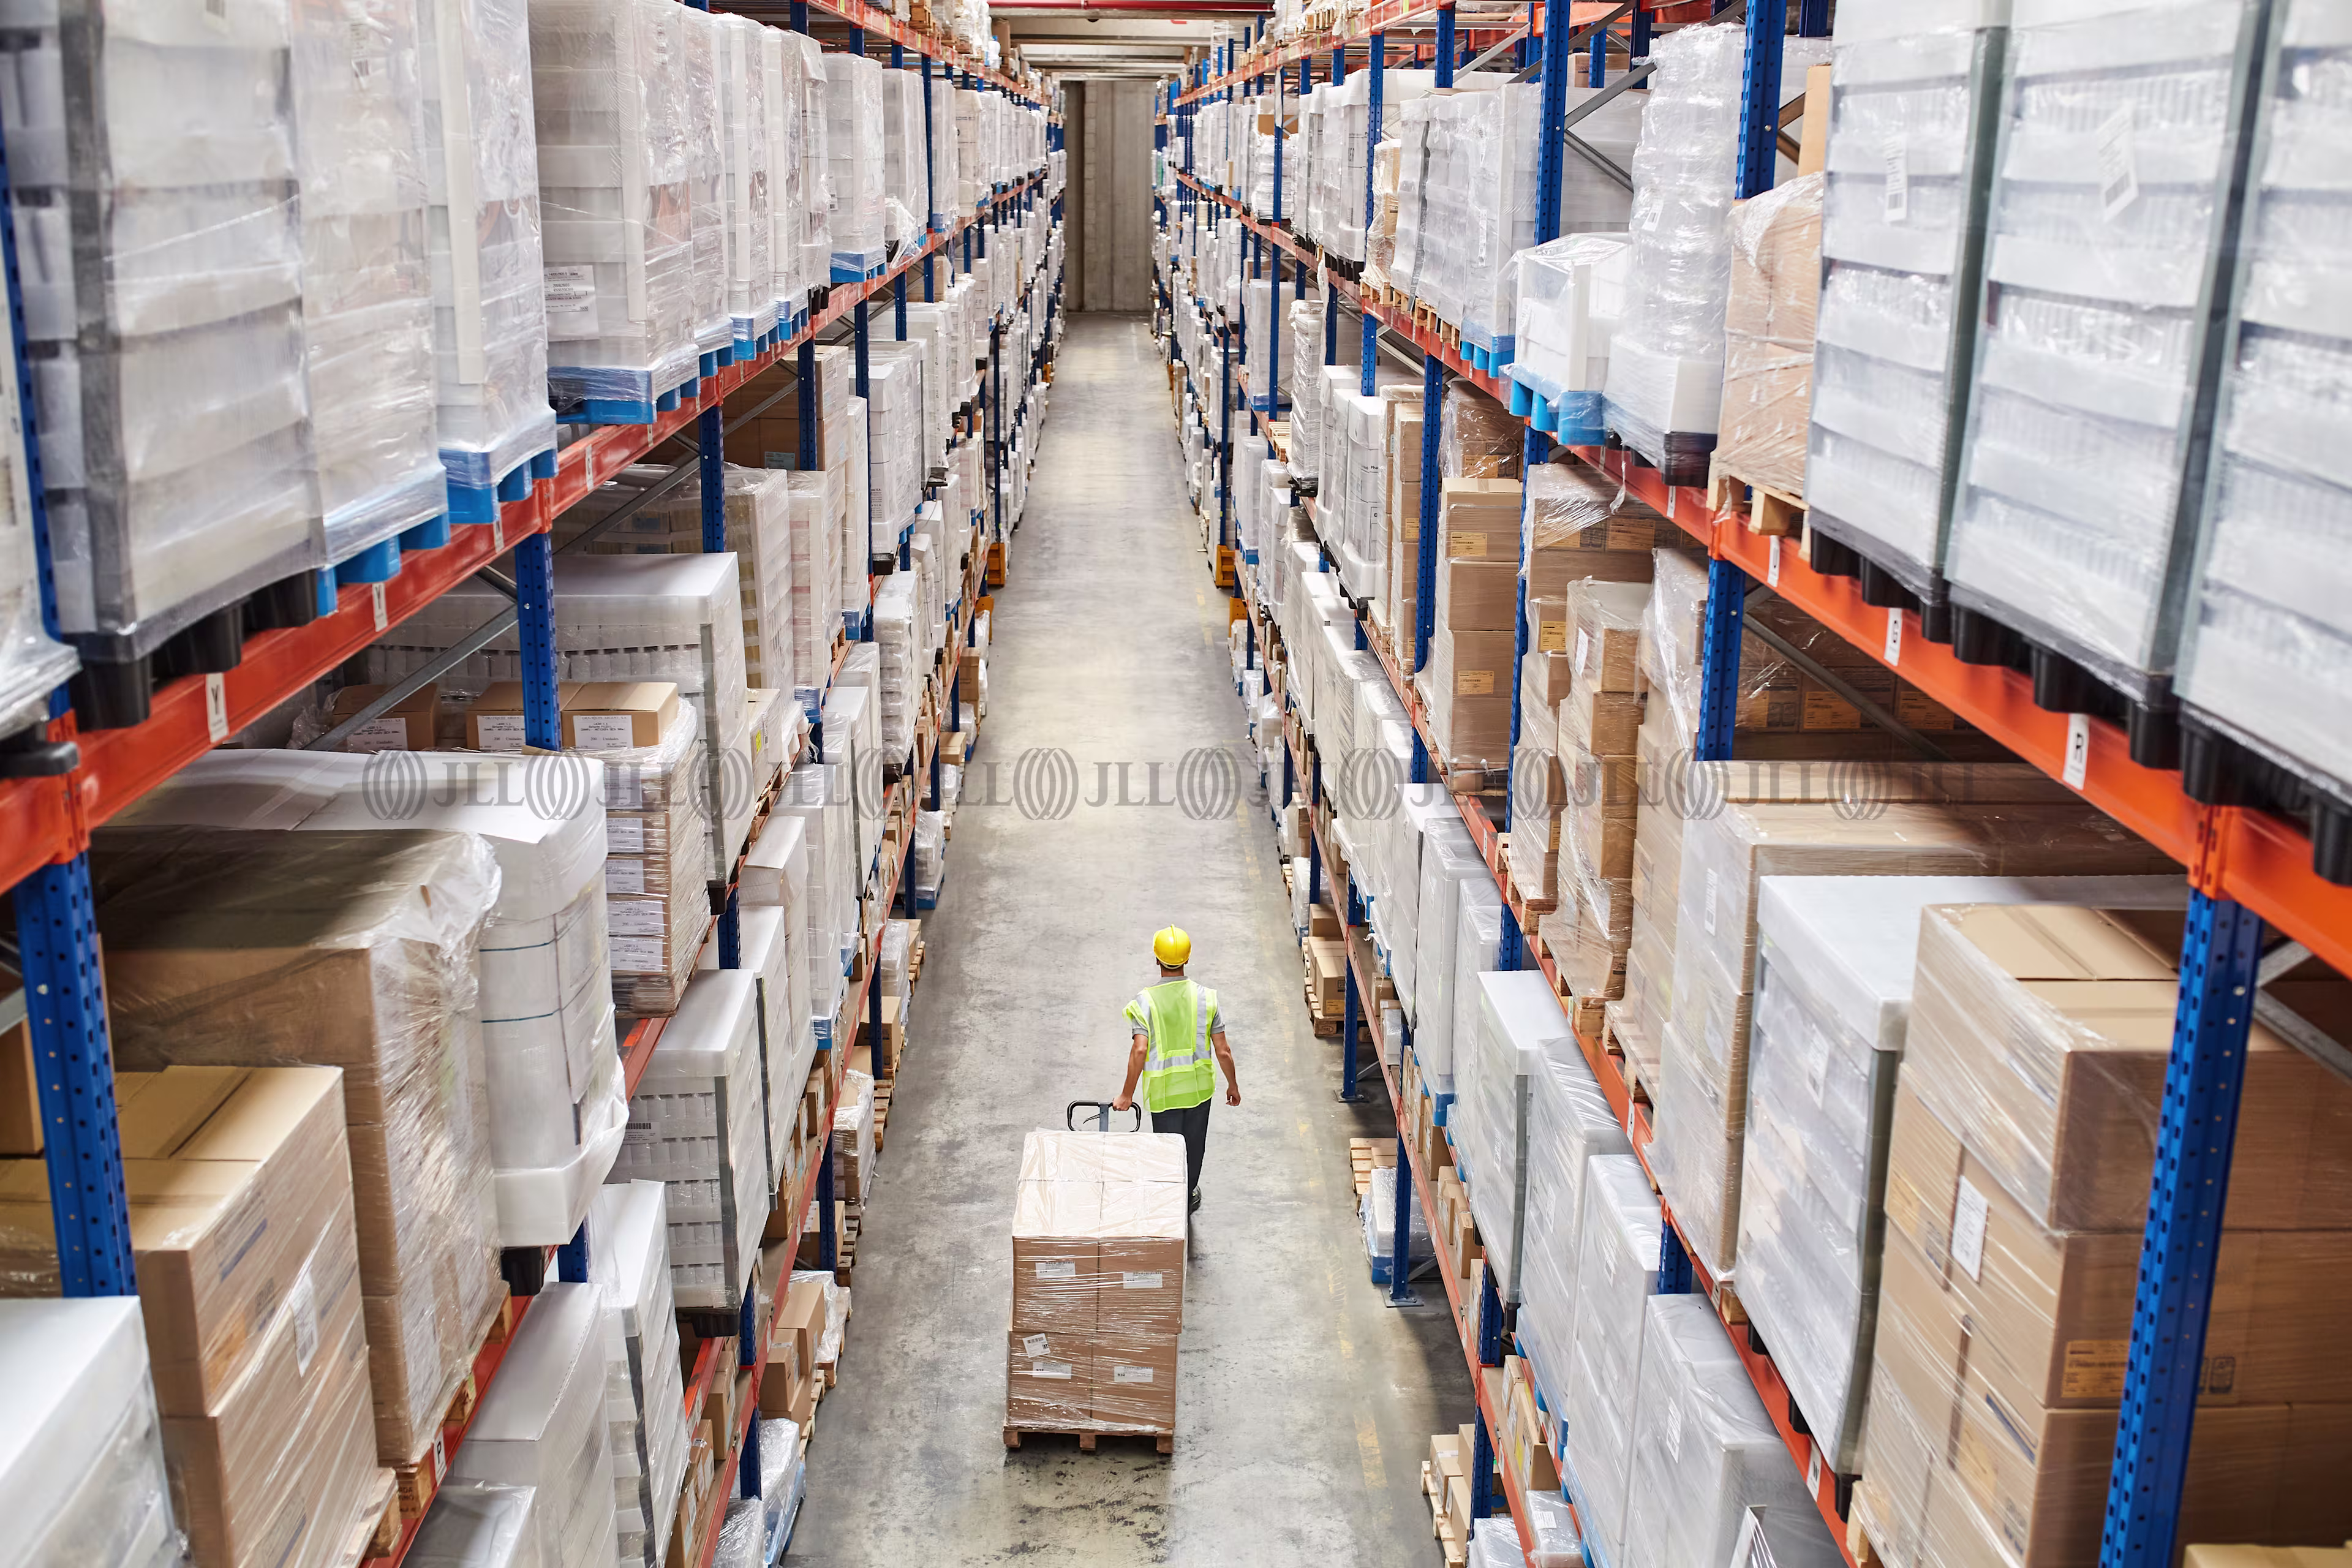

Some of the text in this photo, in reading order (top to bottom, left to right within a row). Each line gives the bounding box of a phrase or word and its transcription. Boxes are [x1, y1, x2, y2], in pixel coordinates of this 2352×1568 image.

[375, 584, 382, 610] Y
[211, 684, 220, 716] Y
[2073, 733, 2084, 764] R
[437, 1441, 442, 1464] P
